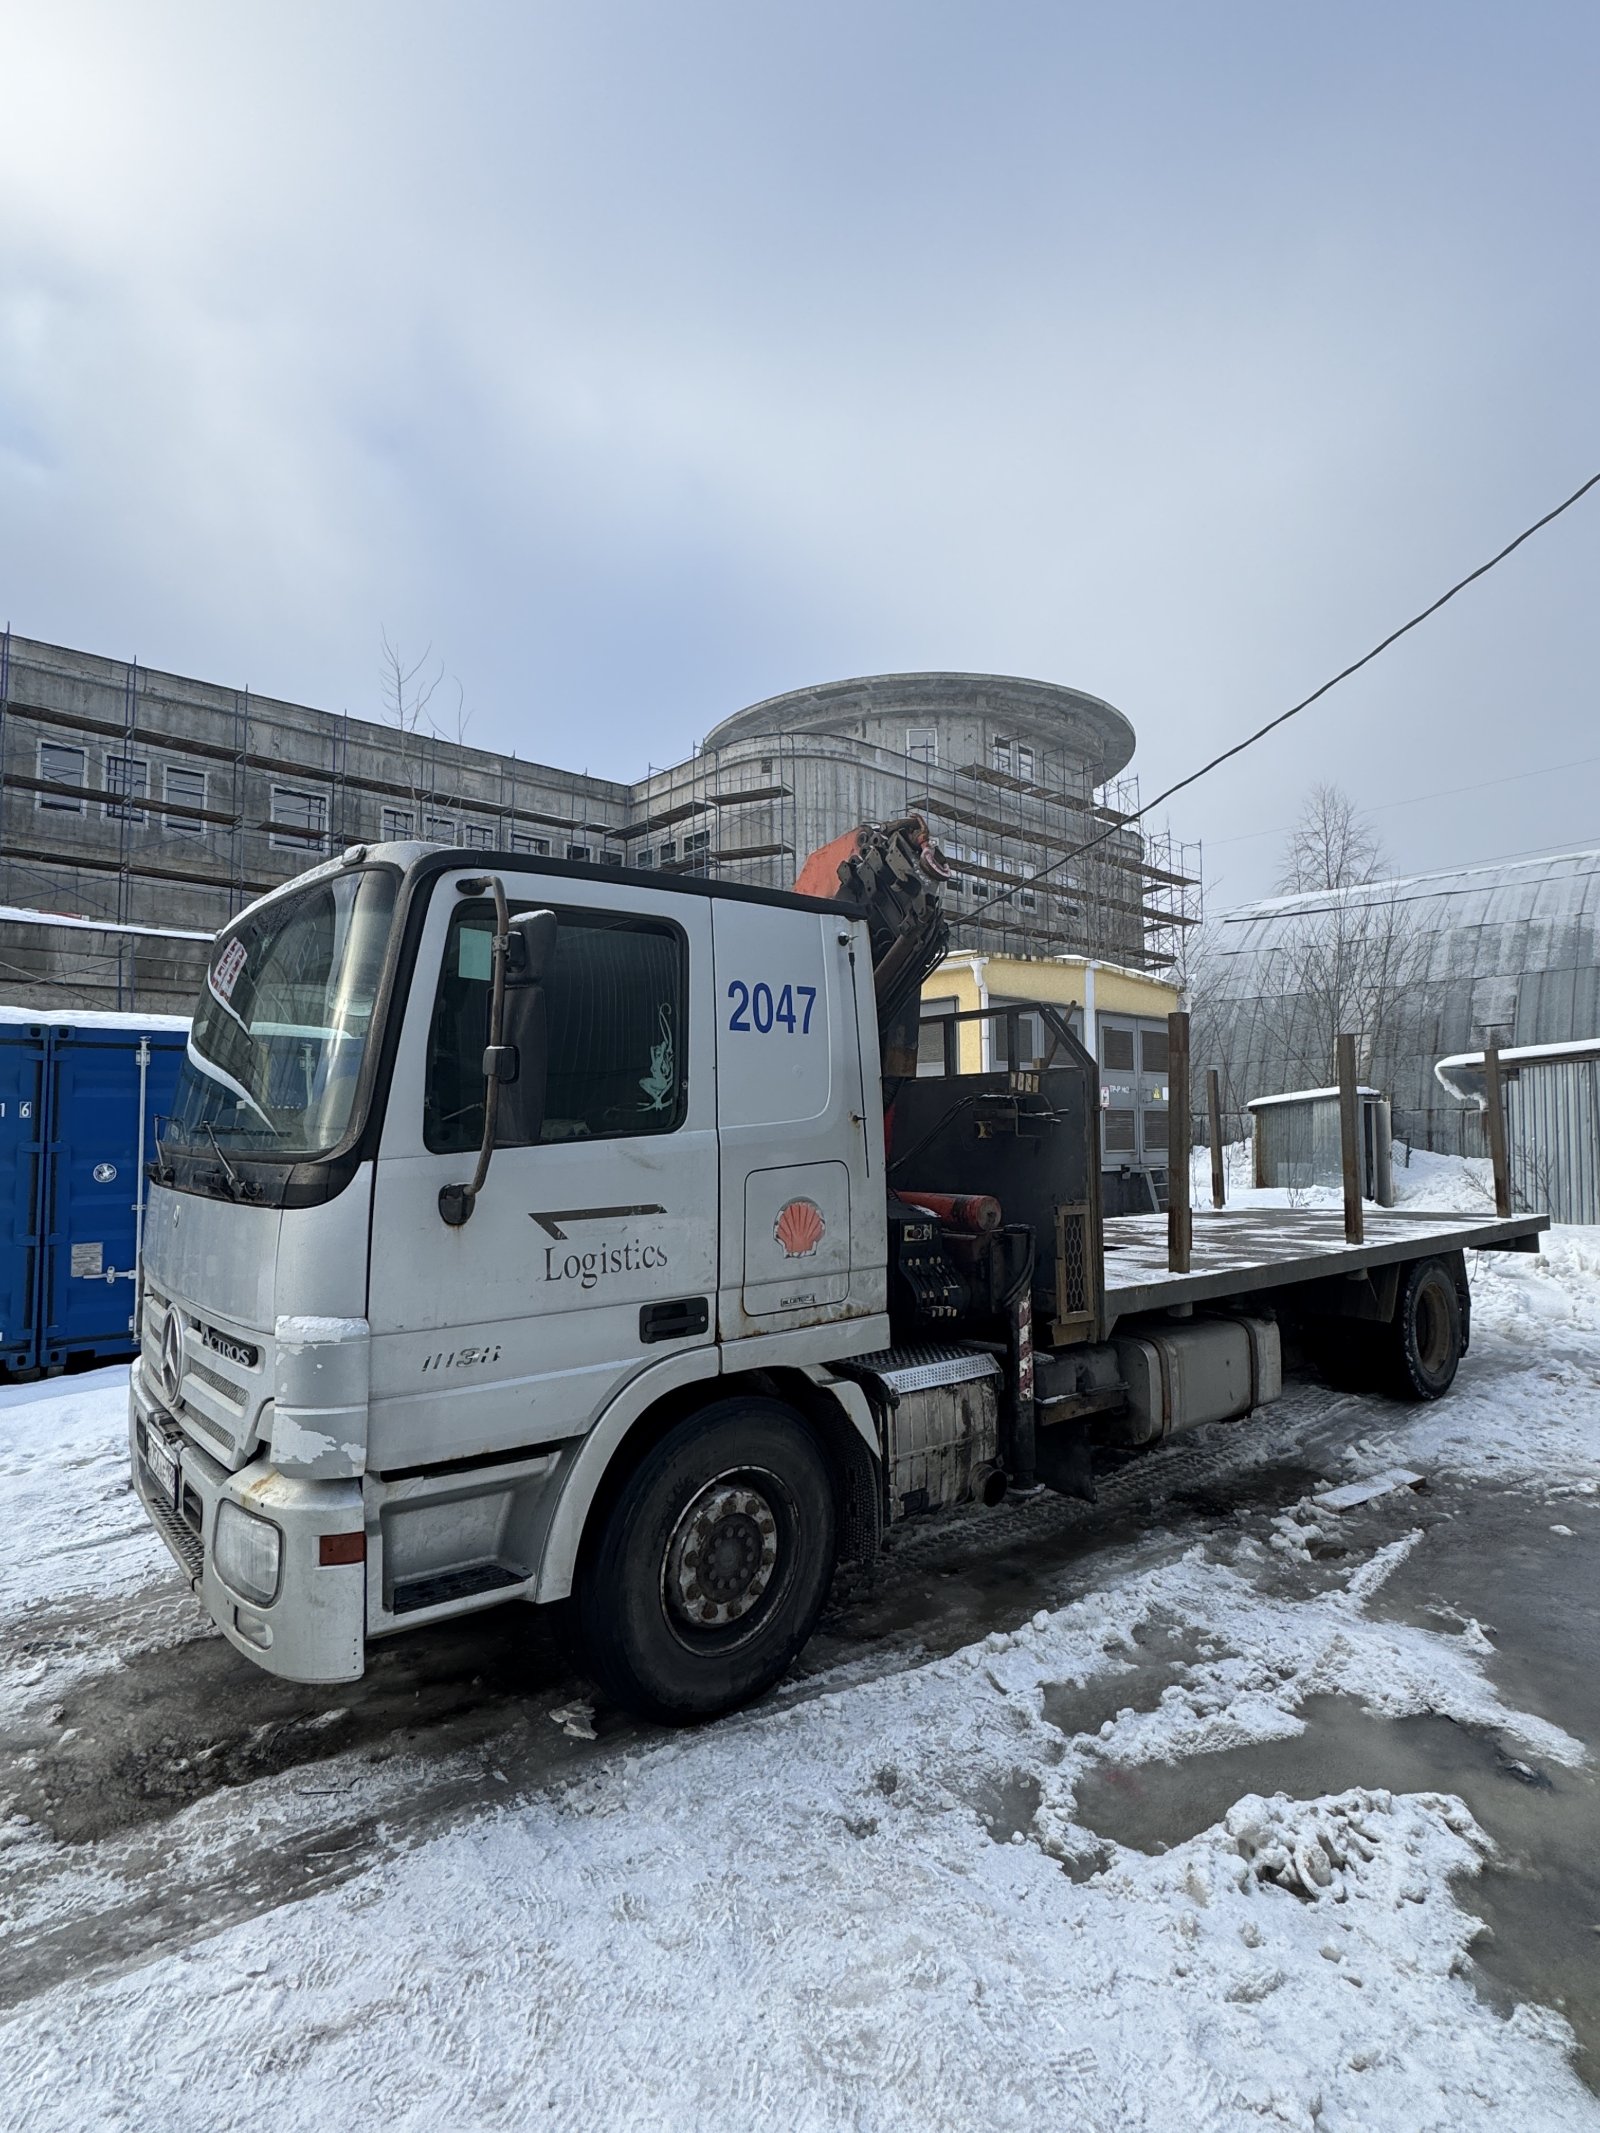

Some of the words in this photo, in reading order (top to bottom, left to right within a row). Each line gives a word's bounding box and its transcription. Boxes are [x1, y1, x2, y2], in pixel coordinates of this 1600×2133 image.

[728, 980, 816, 1034] 2047
[21, 1102, 30, 1117] 6
[543, 1238, 668, 1289] Logistics
